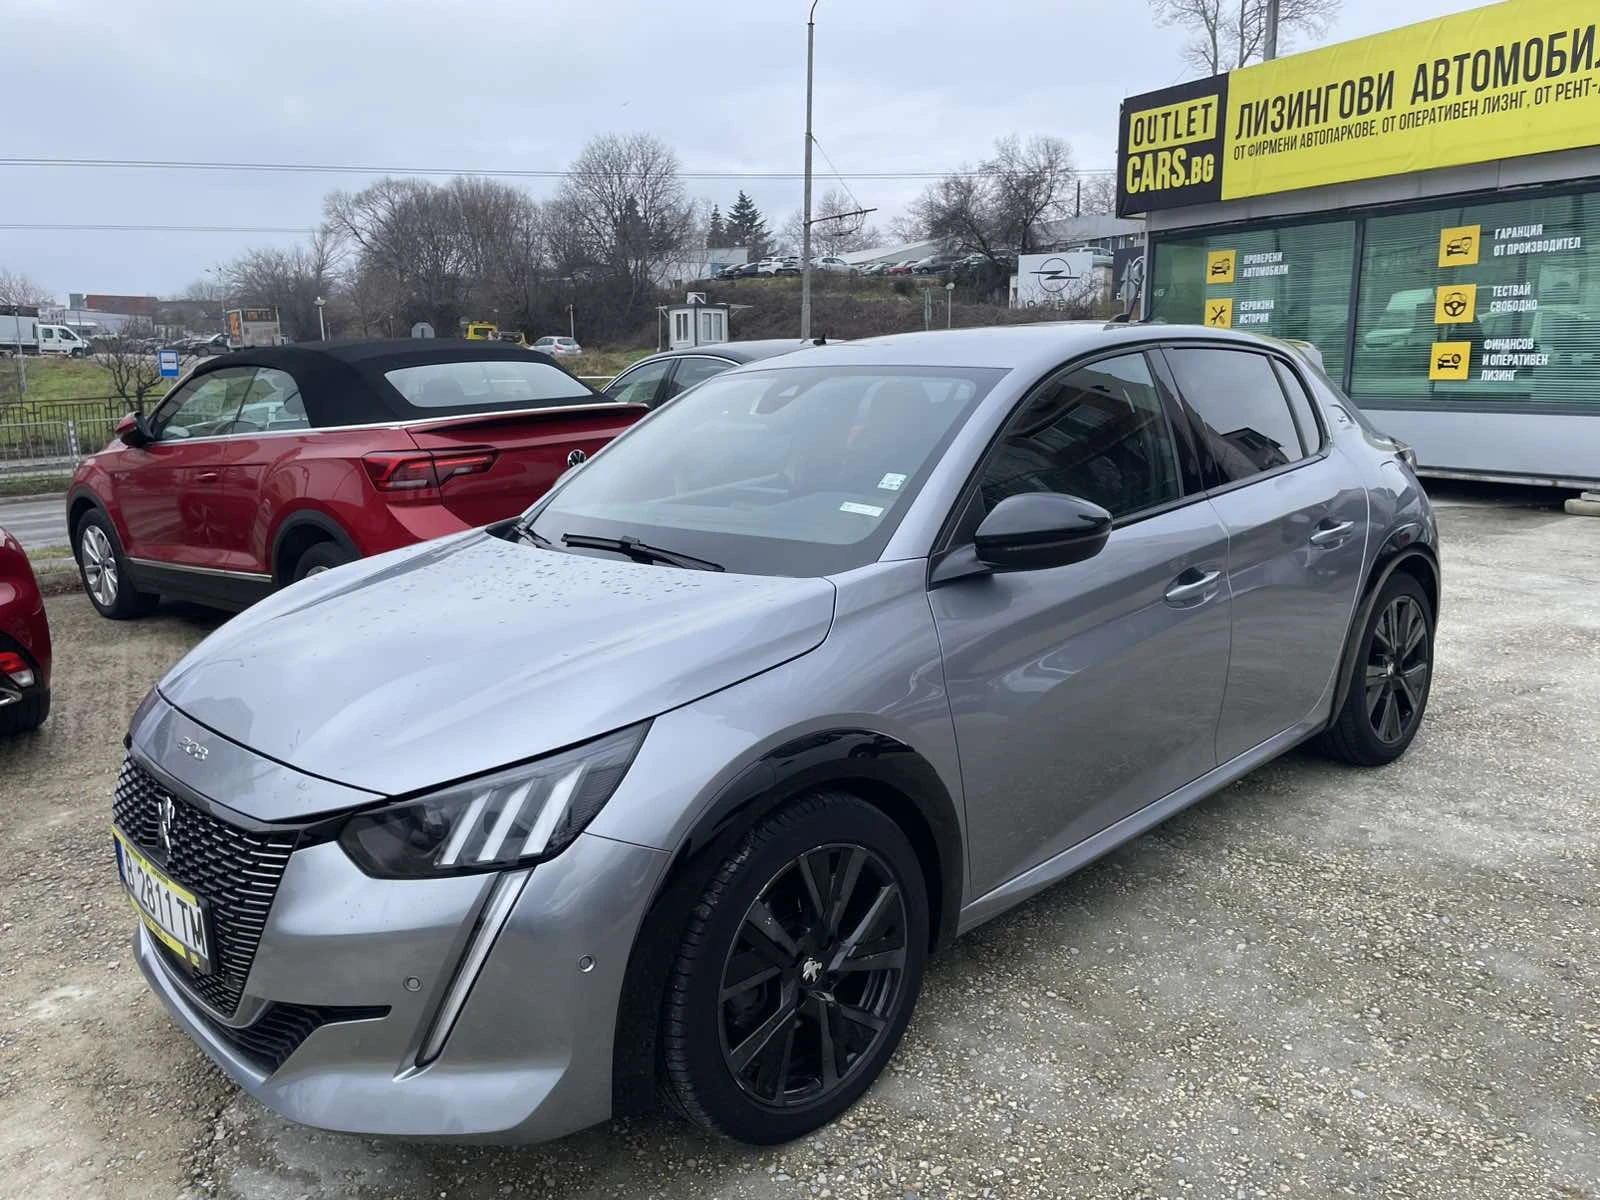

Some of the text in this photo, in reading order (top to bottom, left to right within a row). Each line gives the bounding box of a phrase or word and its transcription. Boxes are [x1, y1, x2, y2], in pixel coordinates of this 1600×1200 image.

[1235, 24, 1600, 140] ЛИЗИНГОВИ АВТОМОБИ
[1134, 102, 1213, 146] OUTLET
[1234, 144, 1246, 160] ОТ
[1248, 135, 1298, 157] ФИРМЕНИ
[1382, 115, 1397, 133] ОТ
[1399, 98, 1479, 130] ОПЕРАТИВЕН
[1534, 85, 1553, 106] ОТ
[1126, 147, 1215, 194] CARS.BG
[1494, 224, 1543, 240] ГАРАНЦИЯ
[1493, 236, 1581, 257] ОТ ПРОИЗВОДИТЕЛ
[1243, 252, 1283, 264] ПРОВЕРЕНИ
[1243, 264, 1288, 277] АВТОМОБИЛИ
[1492, 282, 1531, 297] ТЕСТВАЙ
[1490, 299, 1538, 313] СВОБОДНО
[1239, 312, 1269, 324] ИСТОРИЯ
[1483, 338, 1535, 350] ФИНАНСОВ
[1482, 353, 1549, 366] И ОПЕРАТИВЕН
[1480, 369, 1518, 382] ЛИЗИНГ
[138, 866, 175, 932] 2811
